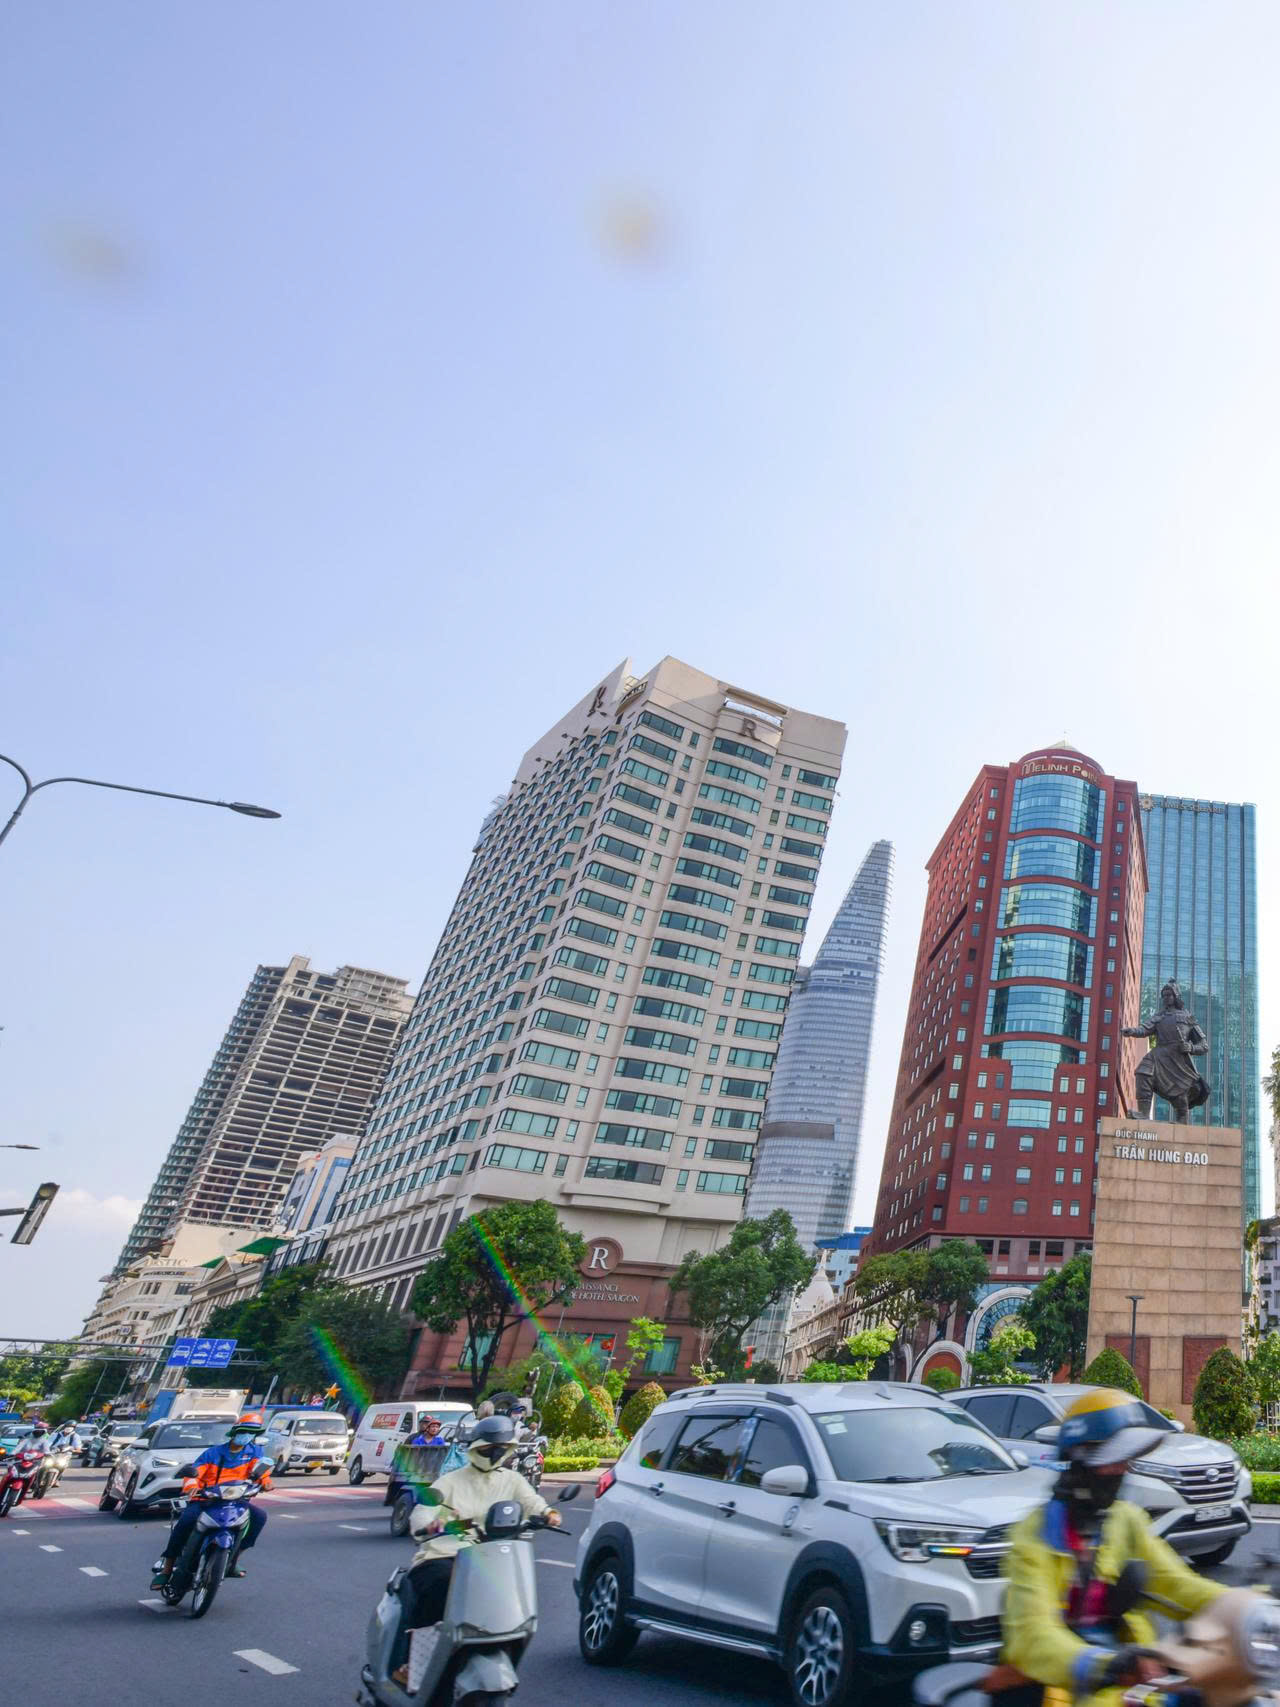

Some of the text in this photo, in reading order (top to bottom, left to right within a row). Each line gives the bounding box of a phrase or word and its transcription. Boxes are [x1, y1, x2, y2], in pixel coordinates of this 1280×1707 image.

[738, 718, 760, 741] R
[1149, 1148, 1181, 1163] HƯNG
[1184, 1152, 1209, 1168] ĐẠO
[588, 1247, 610, 1270] R
[579, 1291, 605, 1301] HOTEL
[607, 1293, 640, 1302] SAIGON
